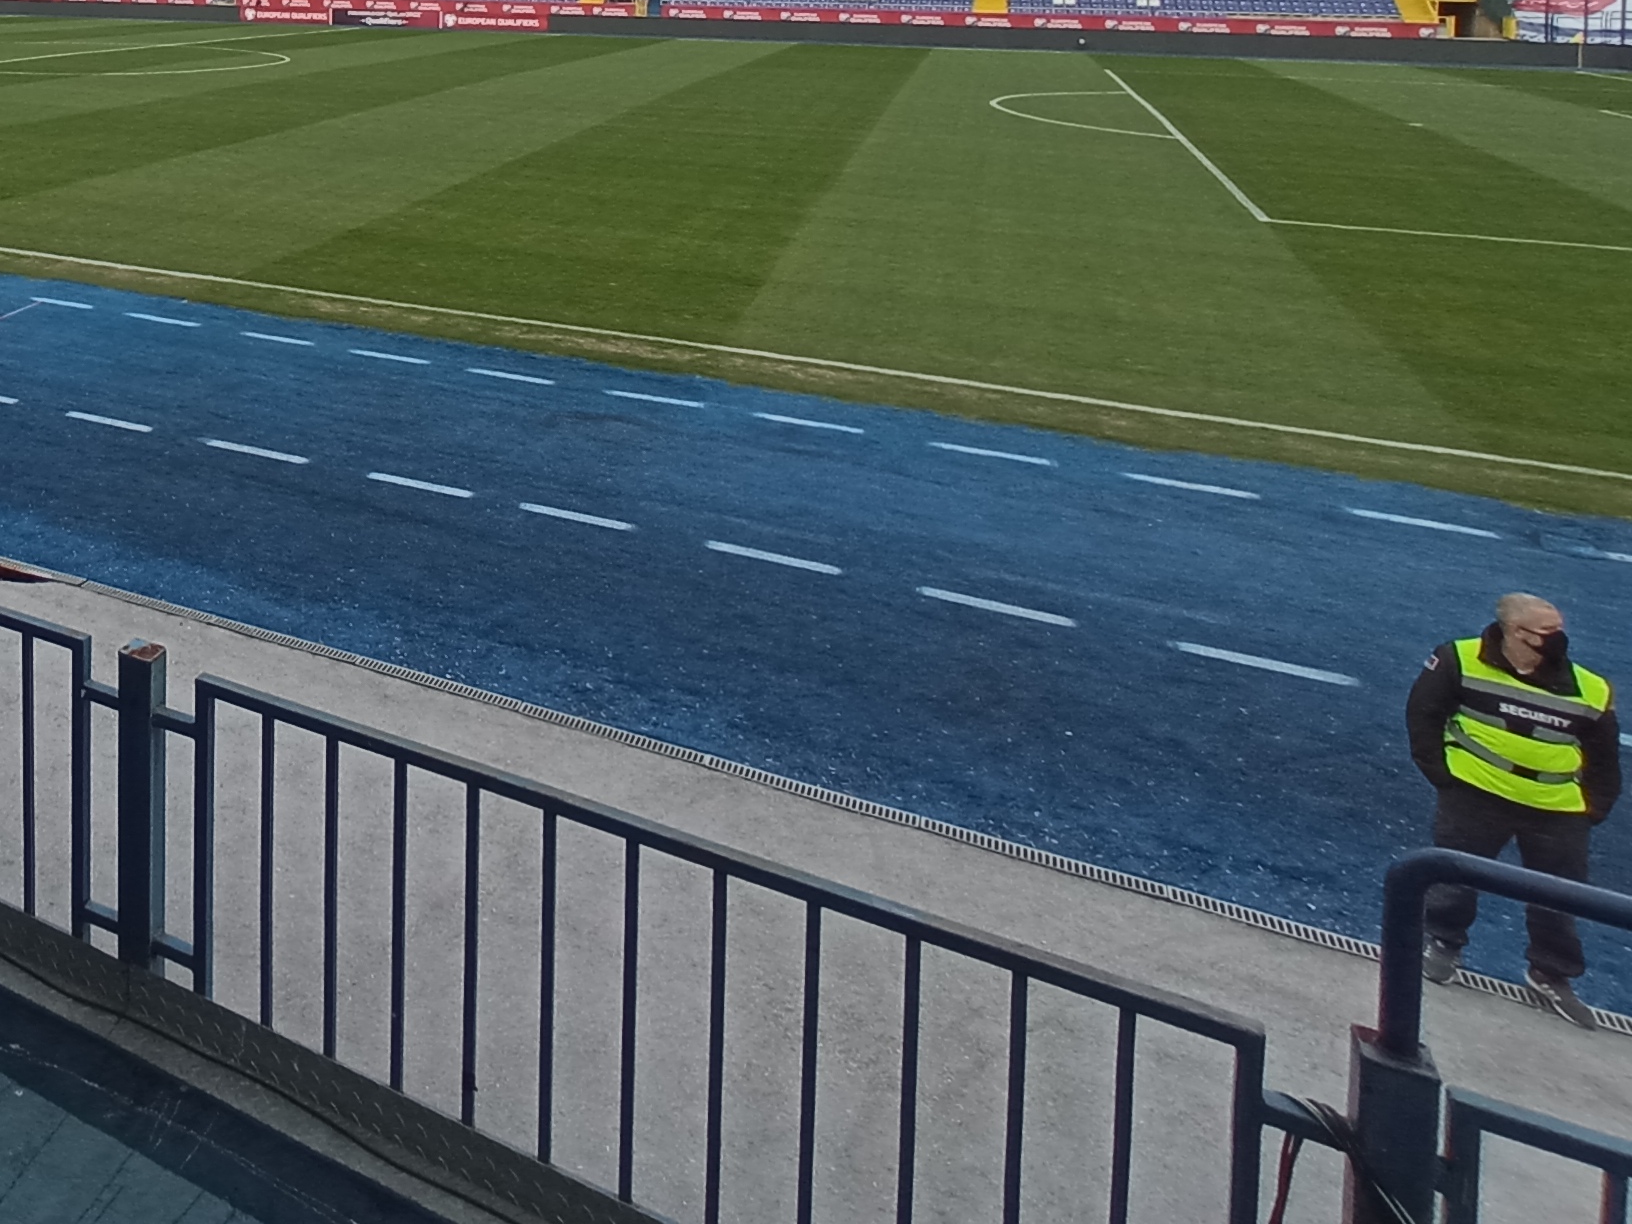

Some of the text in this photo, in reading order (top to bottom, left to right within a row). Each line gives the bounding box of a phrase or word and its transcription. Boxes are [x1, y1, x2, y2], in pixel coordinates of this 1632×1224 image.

[257, 11, 327, 20] EUROPEAN QUALIFIERS
[457, 17, 539, 27] EUROPEAN QUALIFIERS
[1499, 702, 1572, 728] SECURITY
